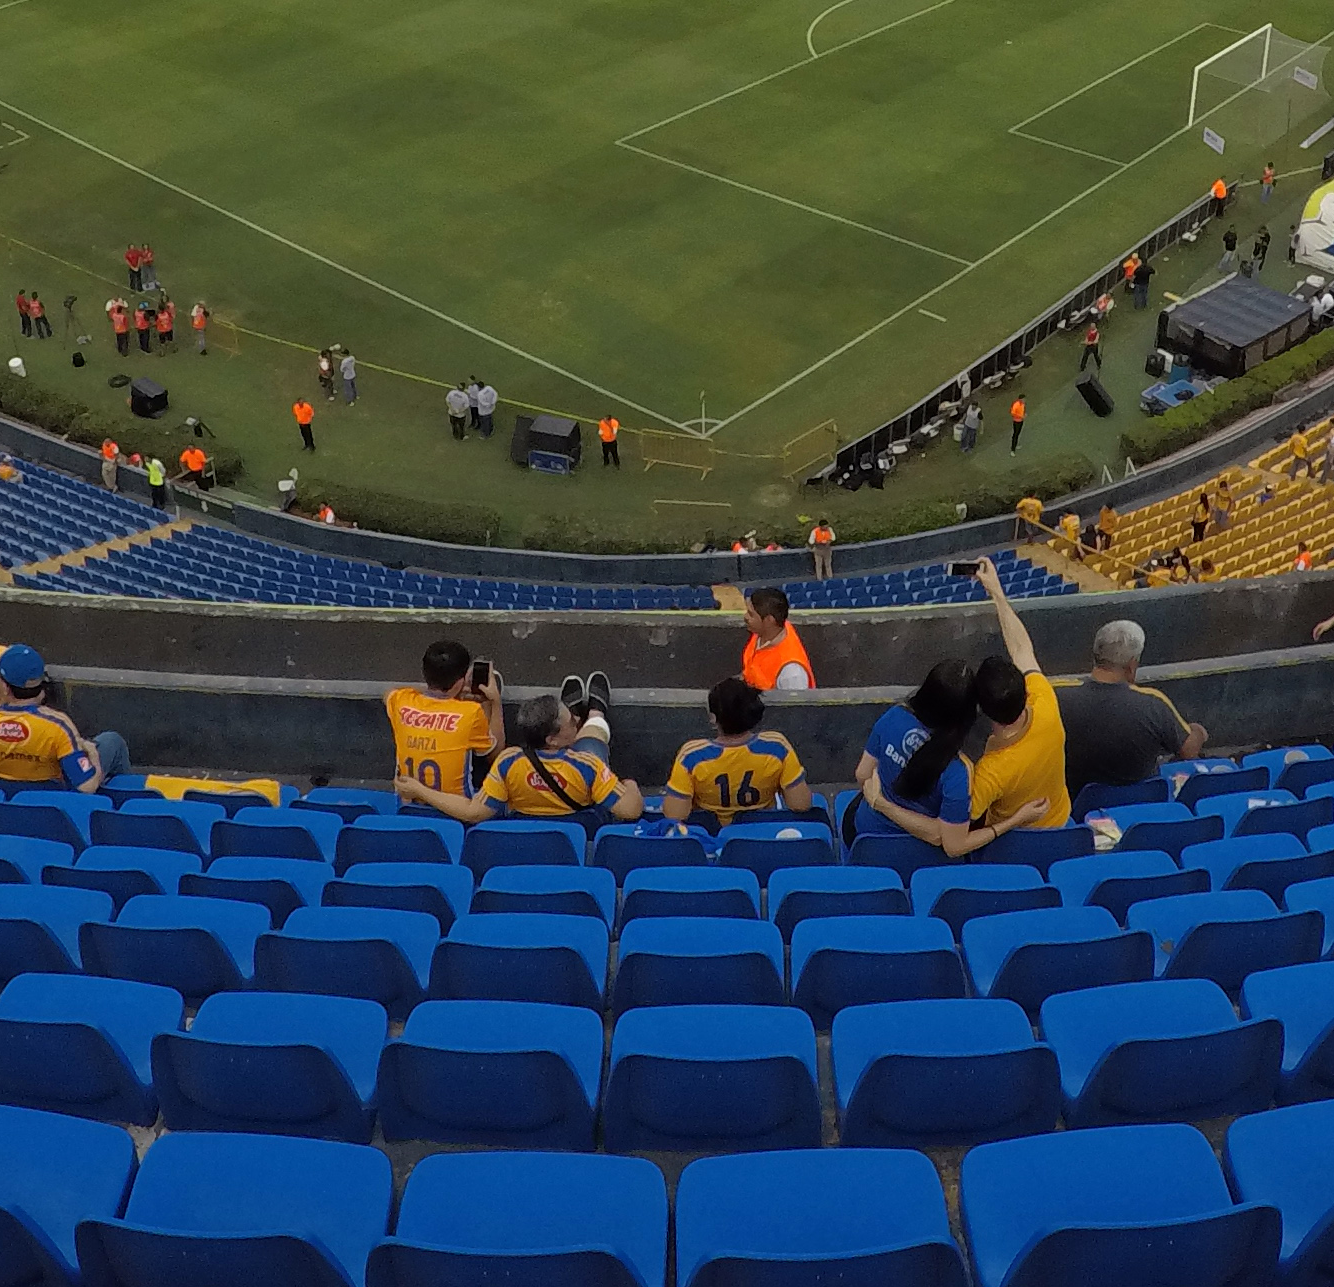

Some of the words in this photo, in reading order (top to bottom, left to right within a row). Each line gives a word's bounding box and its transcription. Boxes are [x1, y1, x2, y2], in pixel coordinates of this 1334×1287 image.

[399, 706, 464, 733] TECATE
[406, 735, 437, 752] GARZA
[714, 770, 761, 808] 16
